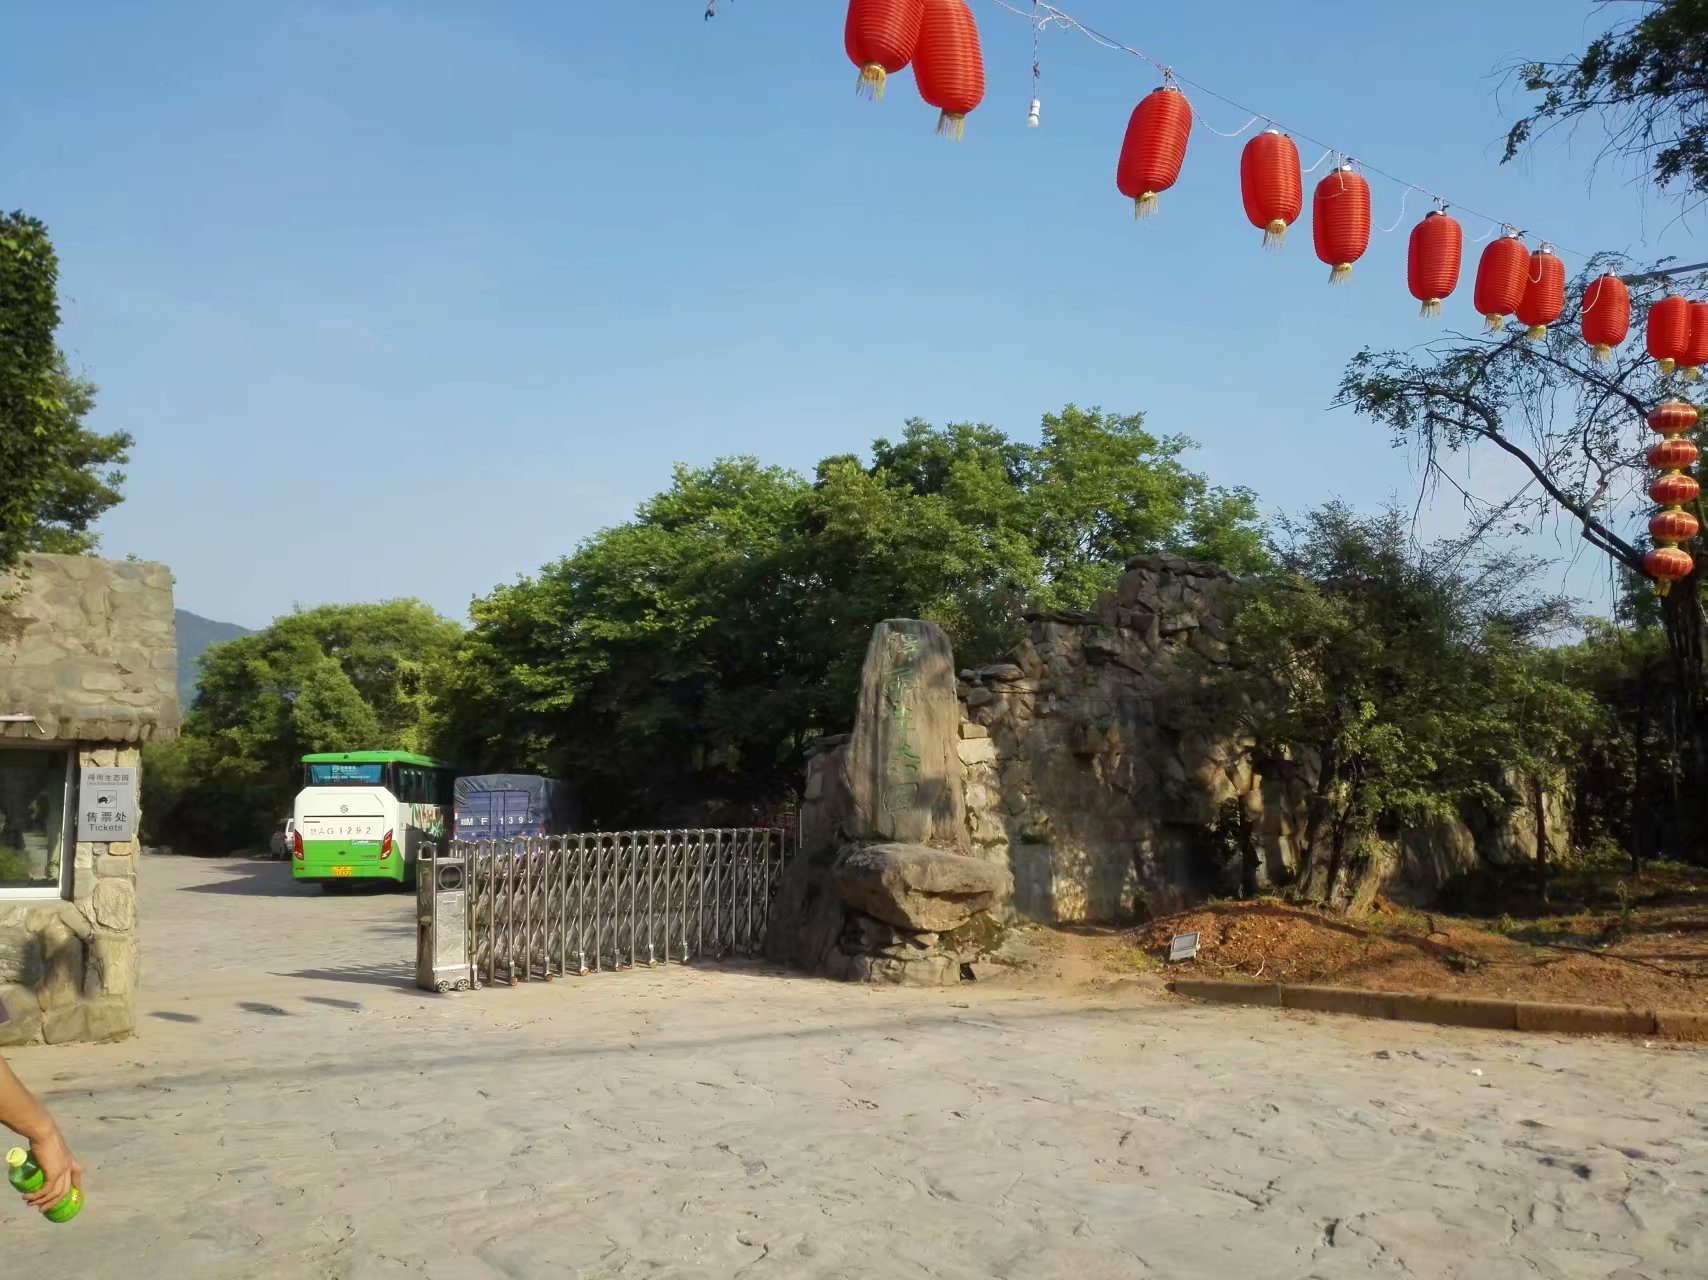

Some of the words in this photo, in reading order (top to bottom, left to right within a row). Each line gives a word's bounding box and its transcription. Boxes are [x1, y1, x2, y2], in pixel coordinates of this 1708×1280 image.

[86, 811, 127, 823] 售票处
[89, 824, 123, 832] Tickets
